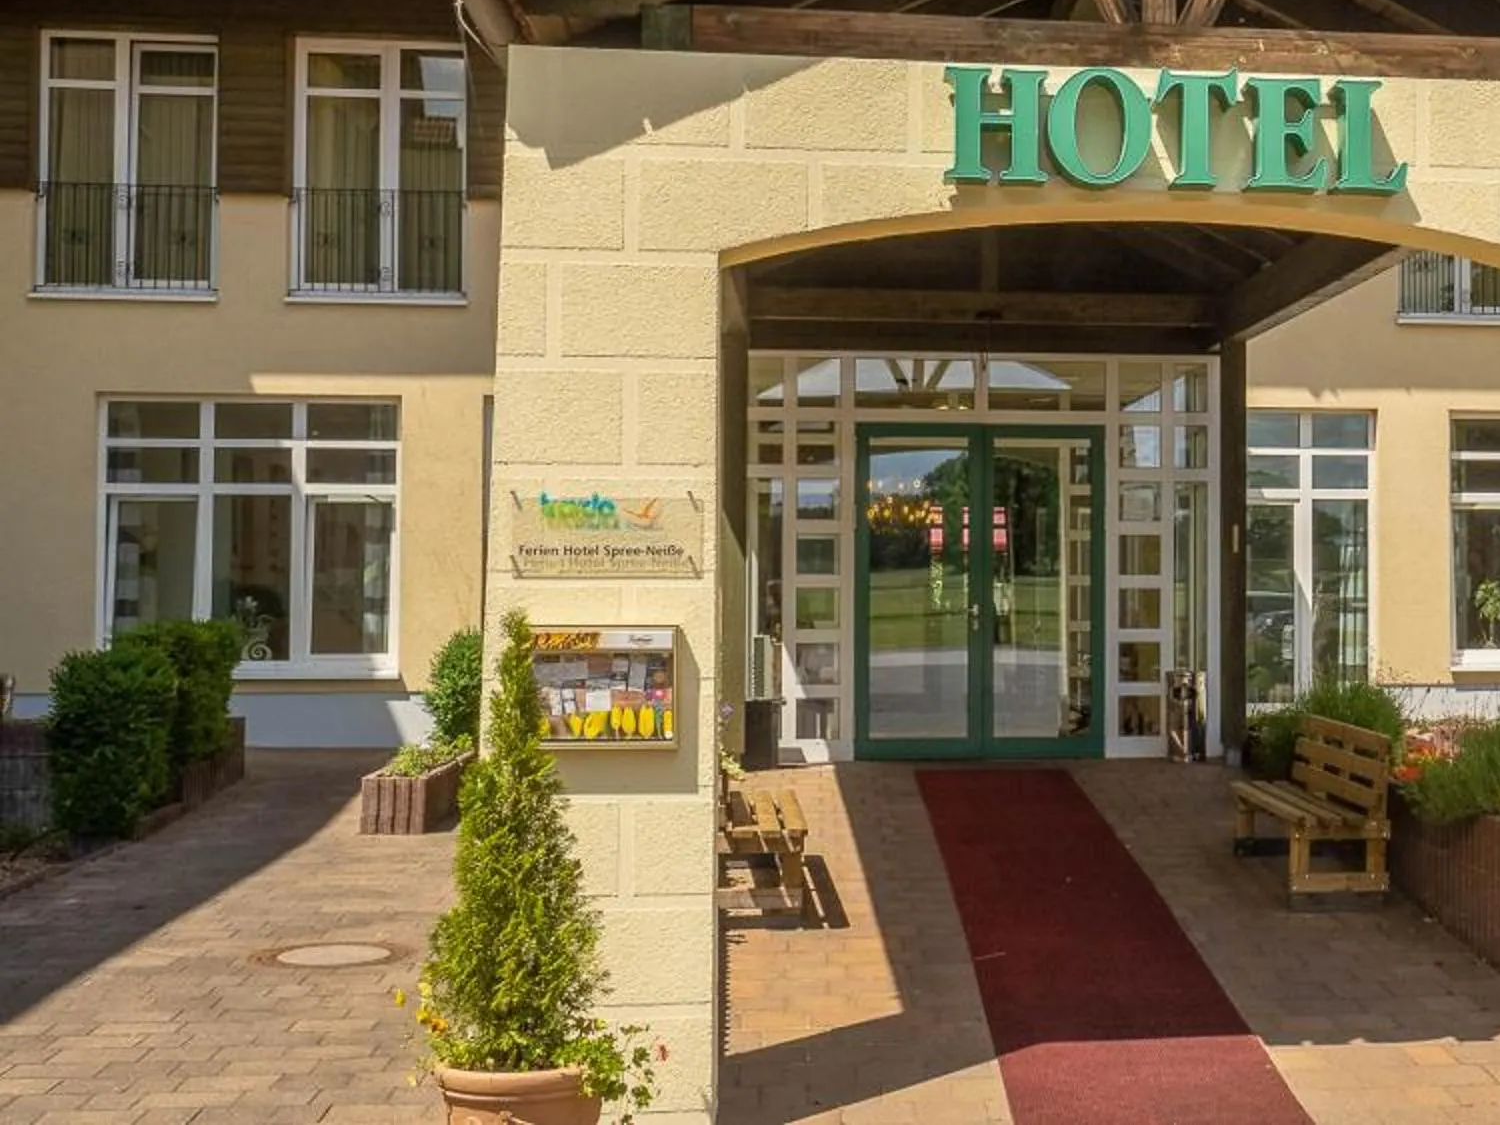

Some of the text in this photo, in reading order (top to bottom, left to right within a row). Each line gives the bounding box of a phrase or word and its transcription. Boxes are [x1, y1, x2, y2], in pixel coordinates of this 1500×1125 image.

[944, 66, 1408, 196] HOTEL
[519, 544, 685, 560] Ferien Hotel Spree-Neiße
